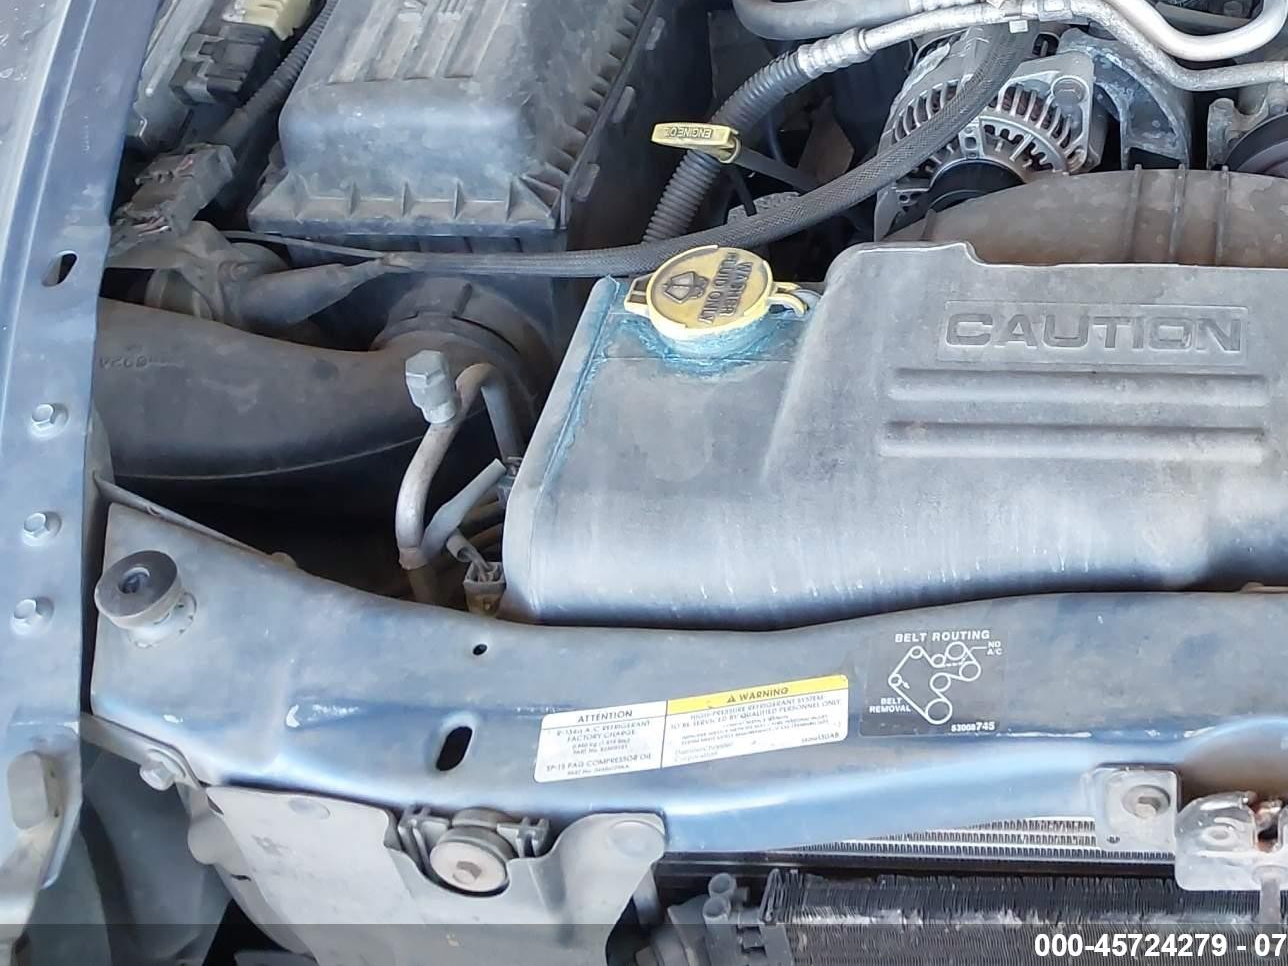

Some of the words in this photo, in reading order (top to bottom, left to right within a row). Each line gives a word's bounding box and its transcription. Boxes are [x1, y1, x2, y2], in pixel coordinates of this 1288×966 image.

[677, 127, 713, 138] ENGINE
[713, 252, 738, 287] FLUID
[719, 260, 754, 317] WASHER
[698, 291, 722, 325] ONLY
[944, 312, 1243, 352] CAUTION
[895, 633, 928, 643] BELT
[932, 630, 990, 641] ROUTING
[739, 687, 789, 701] WARNING
[881, 697, 903, 705] BELT
[869, 705, 911, 713] REMOVAL
[578, 710, 633, 723] ATTENTION
[586, 754, 638, 767] COMPRESSOR
